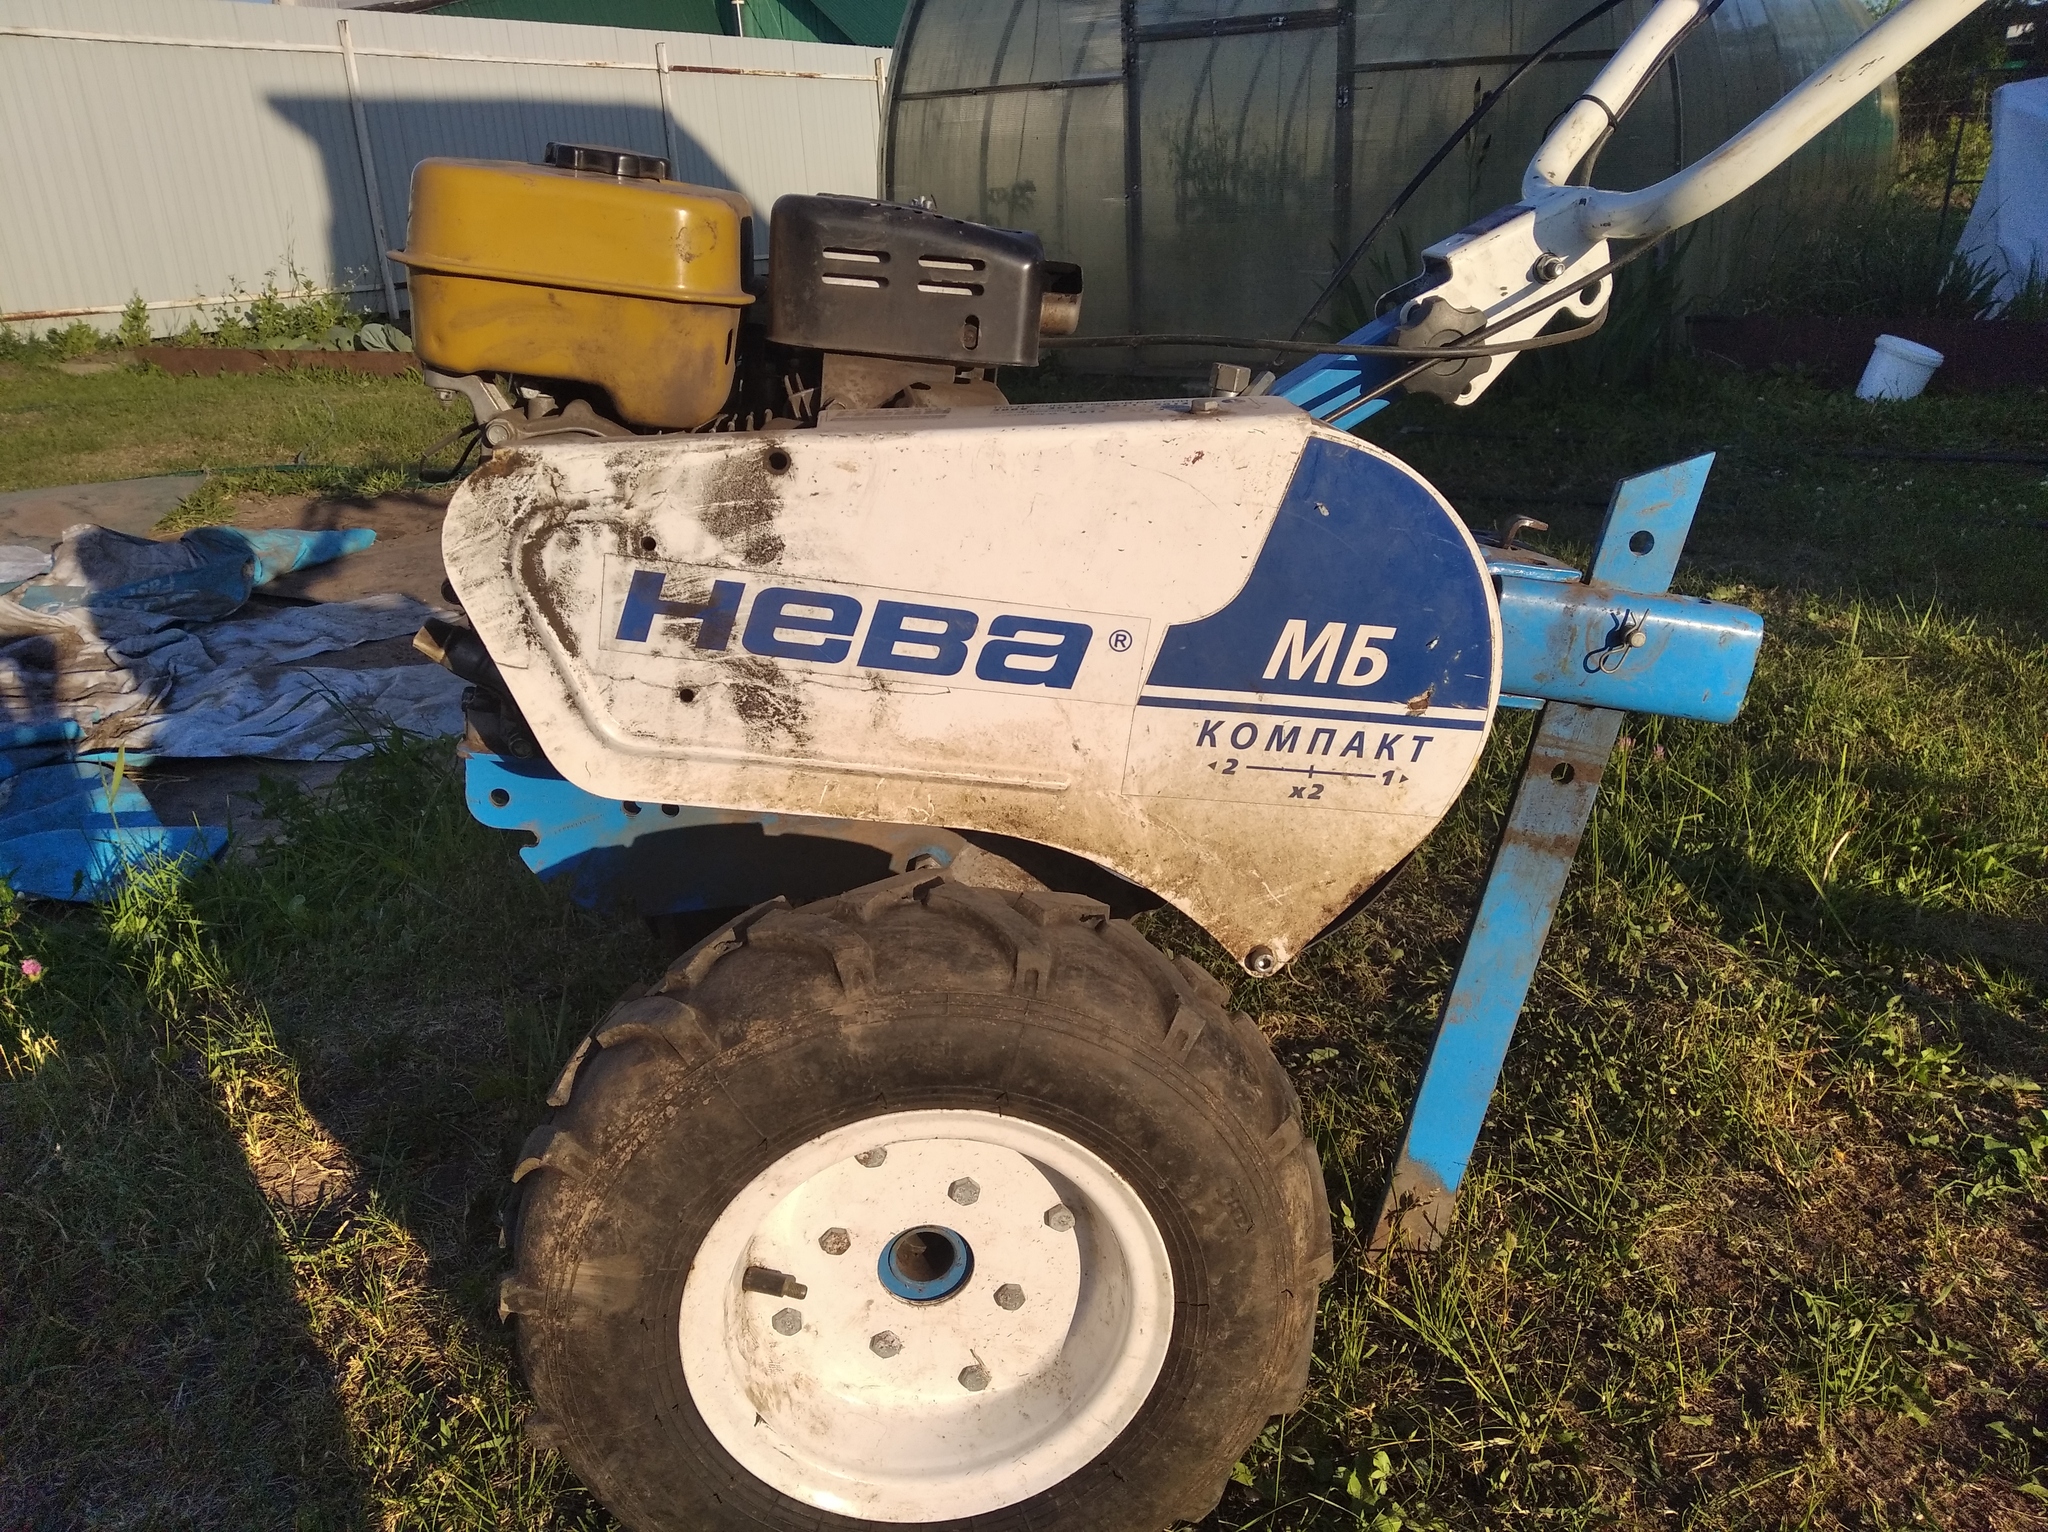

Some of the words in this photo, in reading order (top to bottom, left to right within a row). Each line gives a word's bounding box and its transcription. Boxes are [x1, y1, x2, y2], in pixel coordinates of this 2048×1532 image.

[1262, 619, 1398, 687] МБ
[1196, 719, 1434, 763] КОМПАКТ
[1222, 758, 1239, 775] 2
[1382, 770, 1395, 786] 1
